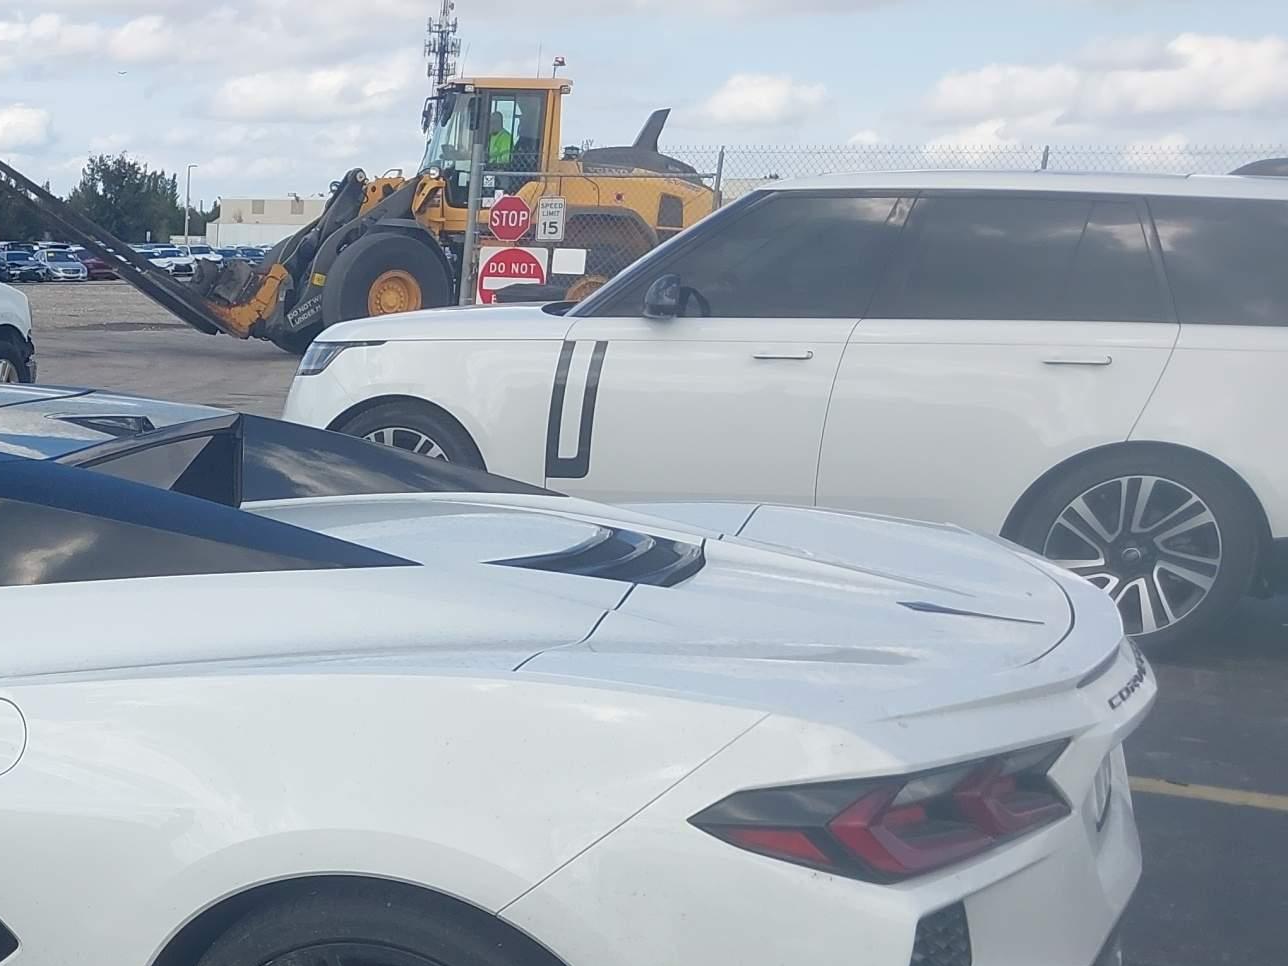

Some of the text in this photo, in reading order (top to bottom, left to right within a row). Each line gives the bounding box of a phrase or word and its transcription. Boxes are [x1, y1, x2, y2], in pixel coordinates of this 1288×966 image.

[491, 210, 529, 227] STOP
[541, 221, 559, 235] 15
[489, 262, 537, 275] DO NOT
